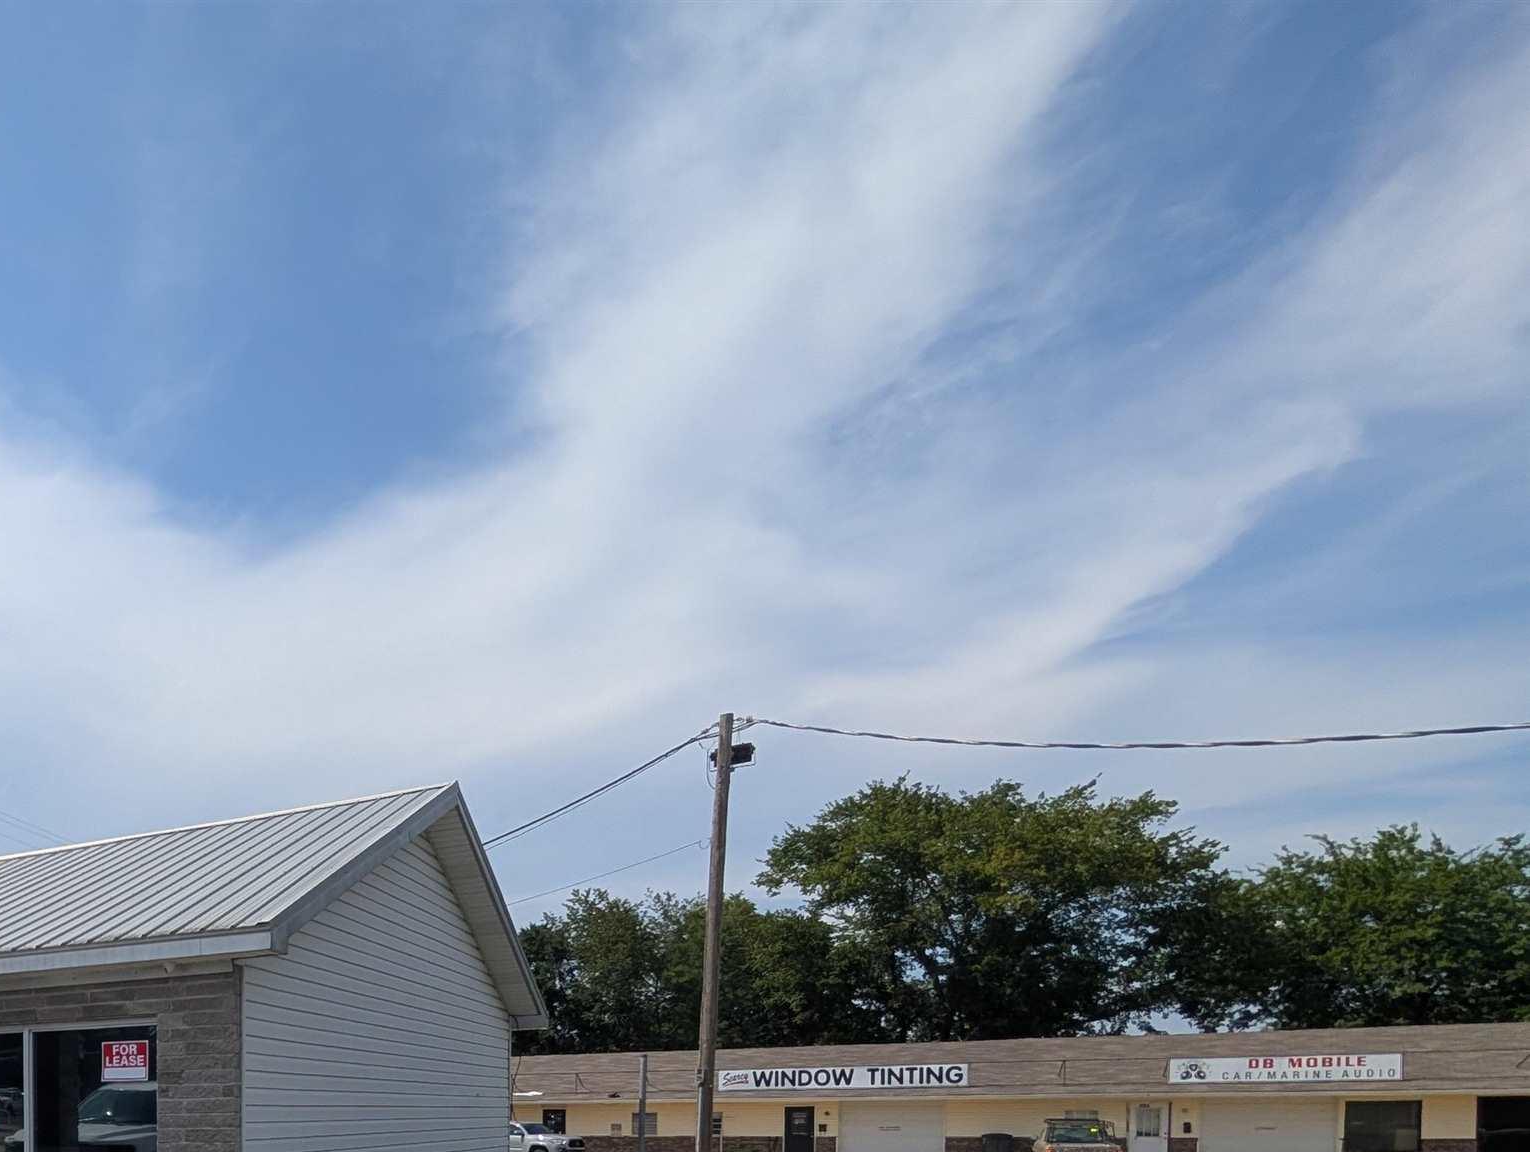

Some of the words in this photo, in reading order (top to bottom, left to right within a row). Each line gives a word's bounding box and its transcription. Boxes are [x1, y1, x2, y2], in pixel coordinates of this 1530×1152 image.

[112, 1044, 138, 1056] FOR
[105, 1055, 145, 1067] LEASE
[1287, 1055, 1368, 1068] MOBILE
[752, 1068, 855, 1088] WINDOW
[866, 1065, 965, 1086] TINTING
[1221, 1069, 1334, 1081] CAR/MARINE
[1341, 1068, 1397, 1079] AUDIO
